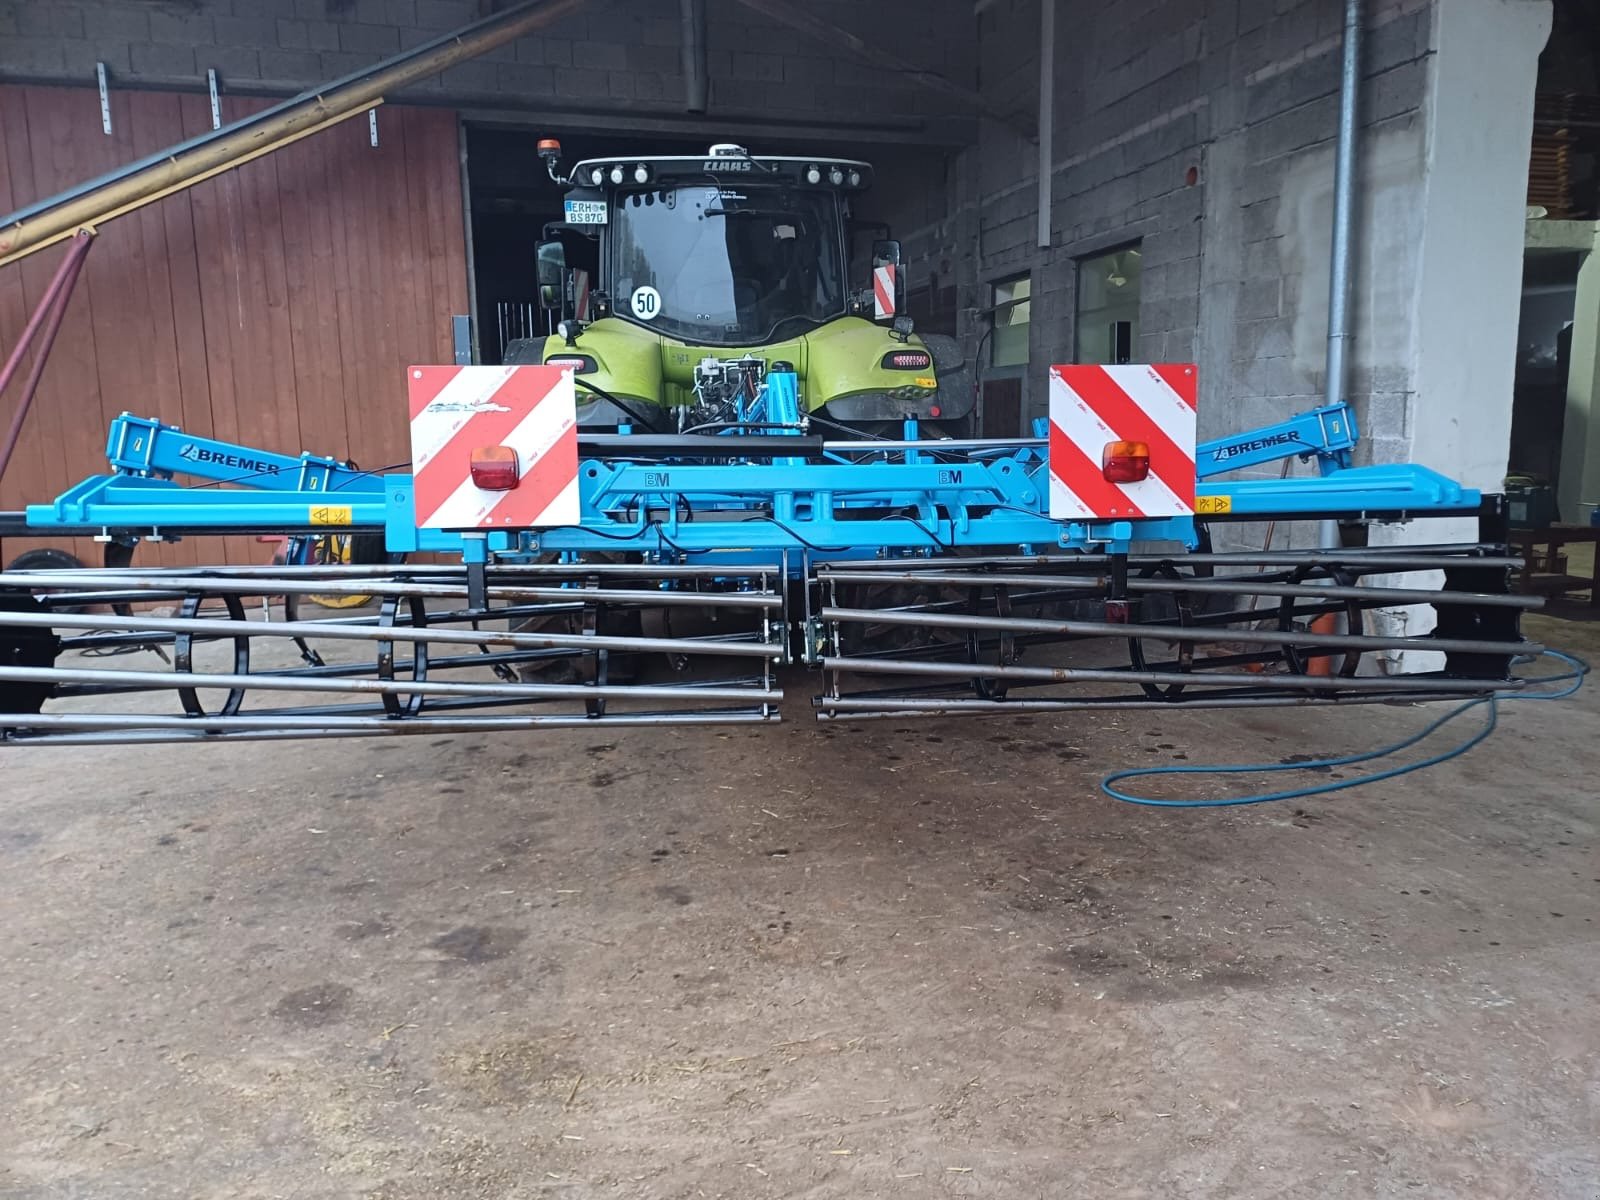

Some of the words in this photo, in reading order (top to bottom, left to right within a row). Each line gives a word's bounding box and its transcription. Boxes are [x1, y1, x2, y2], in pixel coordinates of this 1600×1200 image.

[703, 161, 751, 171] CLAAS
[572, 203, 592, 212] ERH
[570, 213, 583, 222] BS
[584, 213, 603, 223] 870
[637, 293, 655, 313] 50
[1228, 431, 1300, 457] BREMER
[198, 448, 280, 476] BREMER
[644, 472, 670, 487] BM
[939, 470, 962, 485] BM
